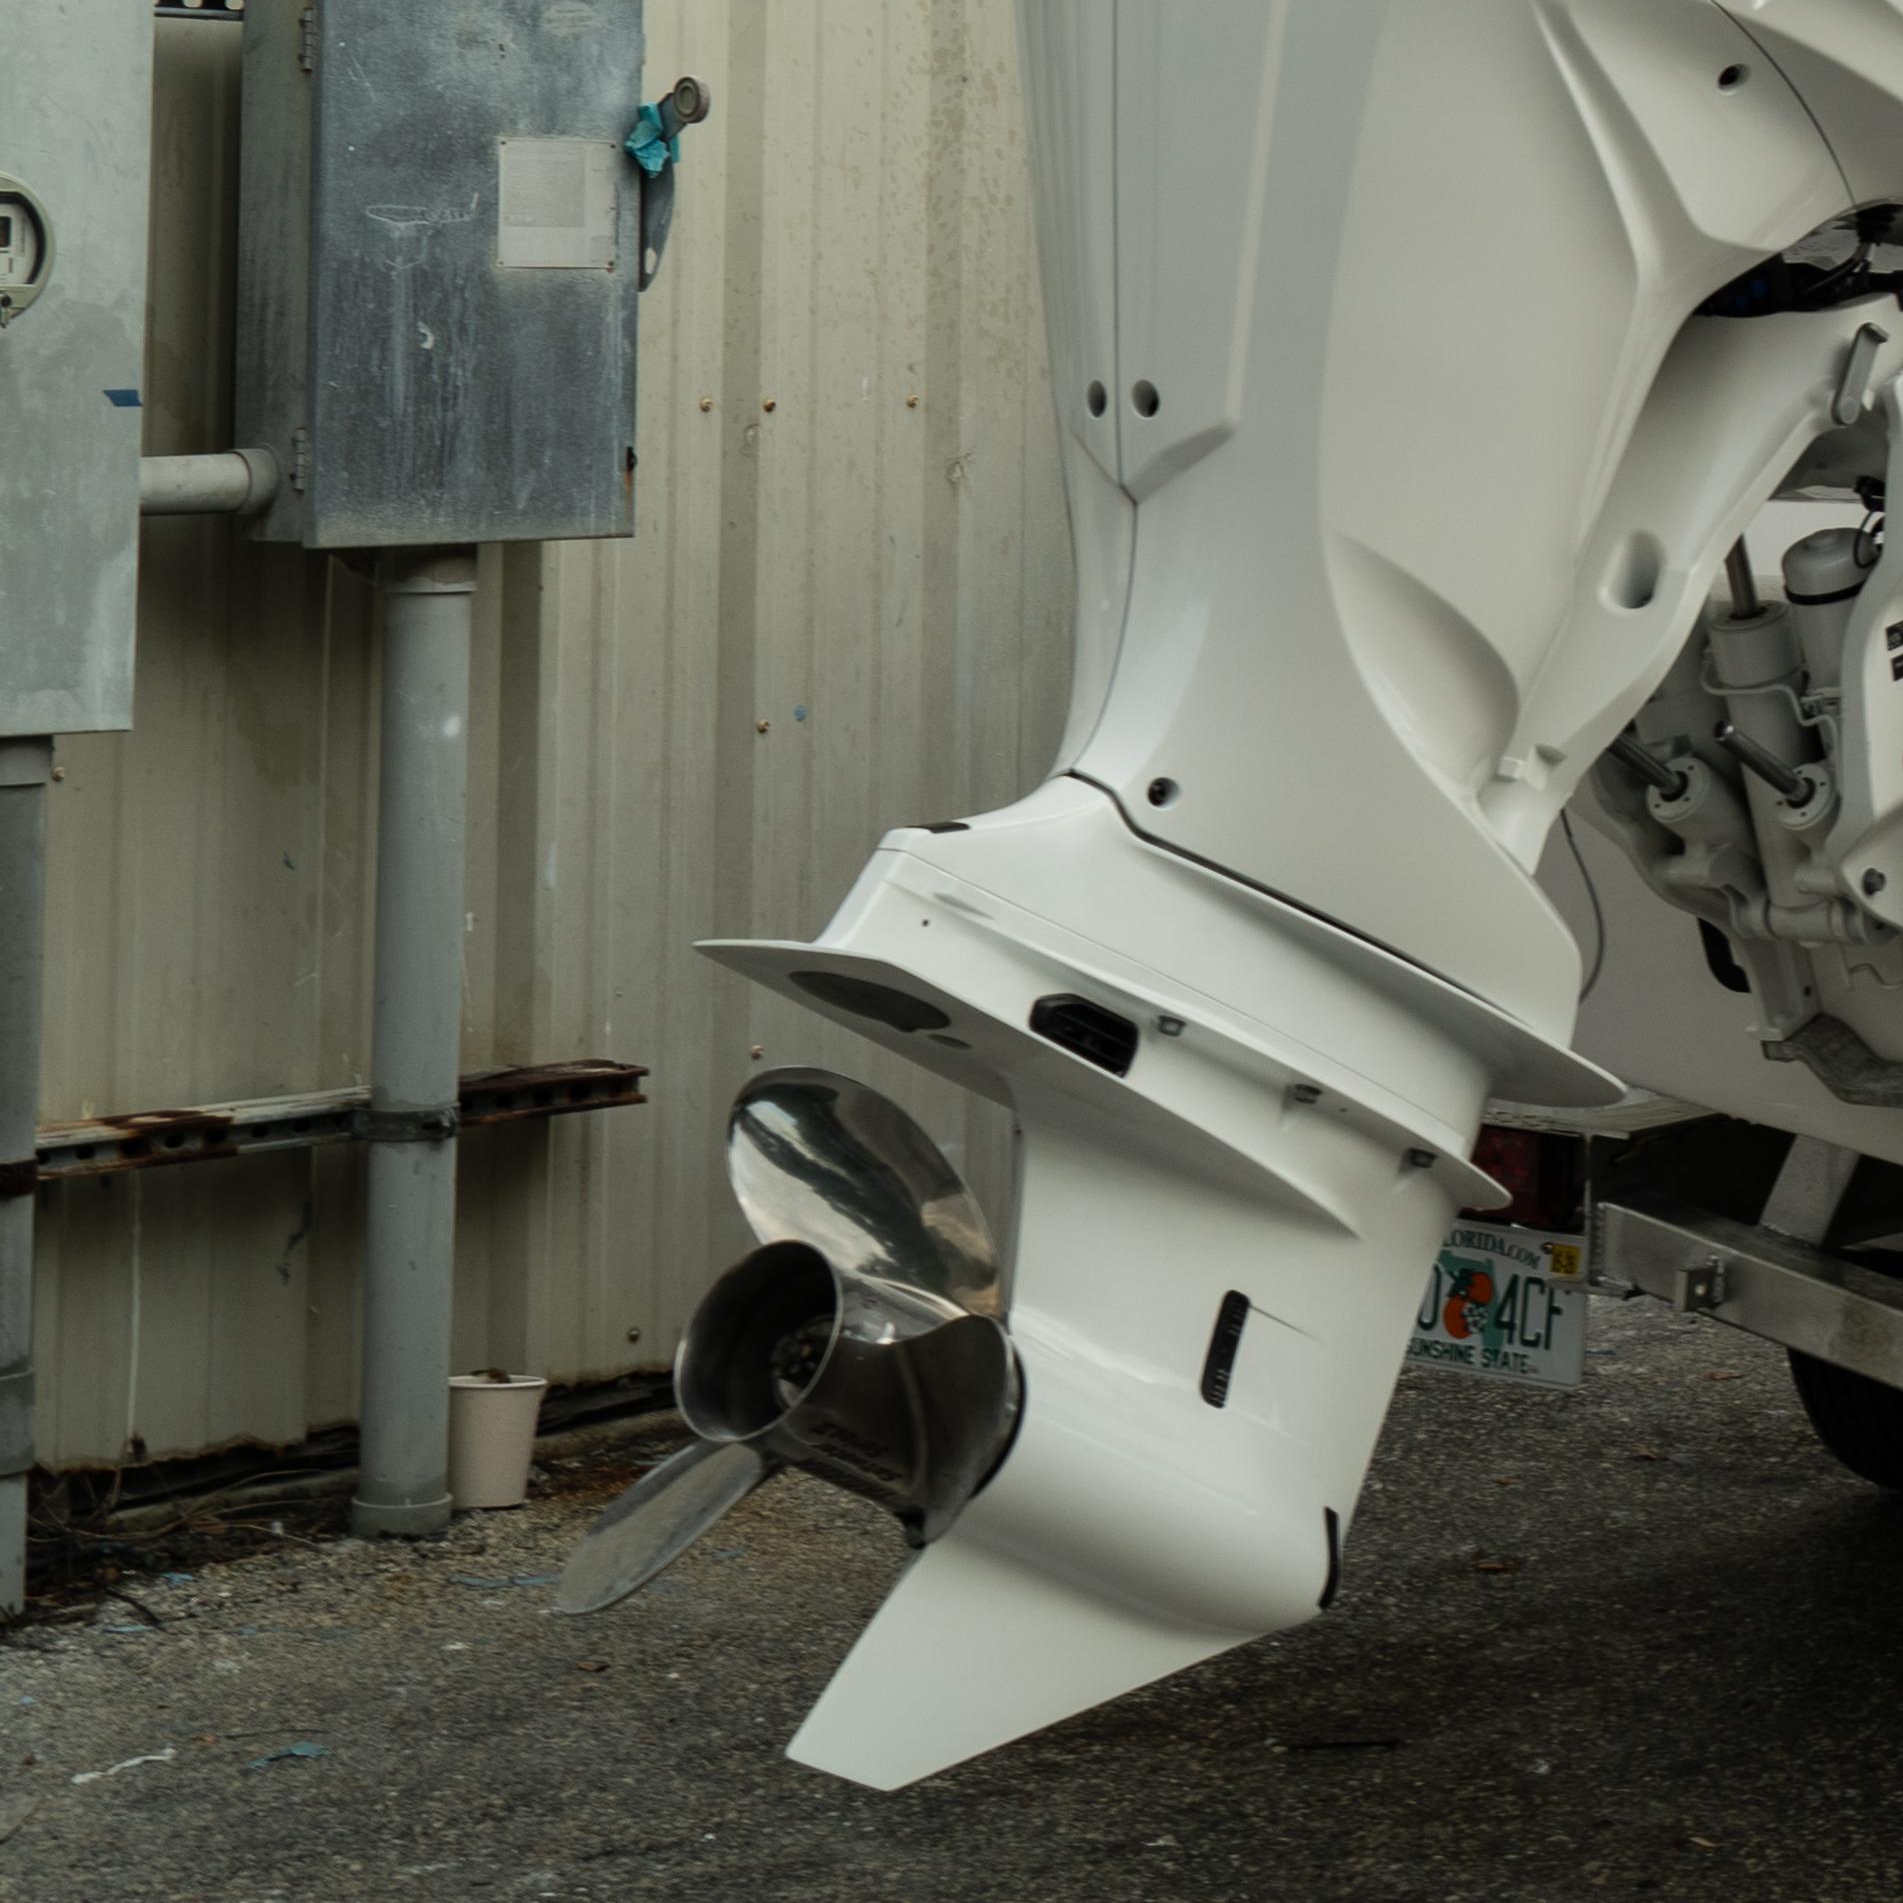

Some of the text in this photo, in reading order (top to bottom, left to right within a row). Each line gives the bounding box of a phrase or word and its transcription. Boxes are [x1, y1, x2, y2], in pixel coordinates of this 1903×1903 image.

[1443, 1229, 1541, 1269] ORIDA.COM
[1408, 1336, 1530, 1374] UNSHINE STATE
